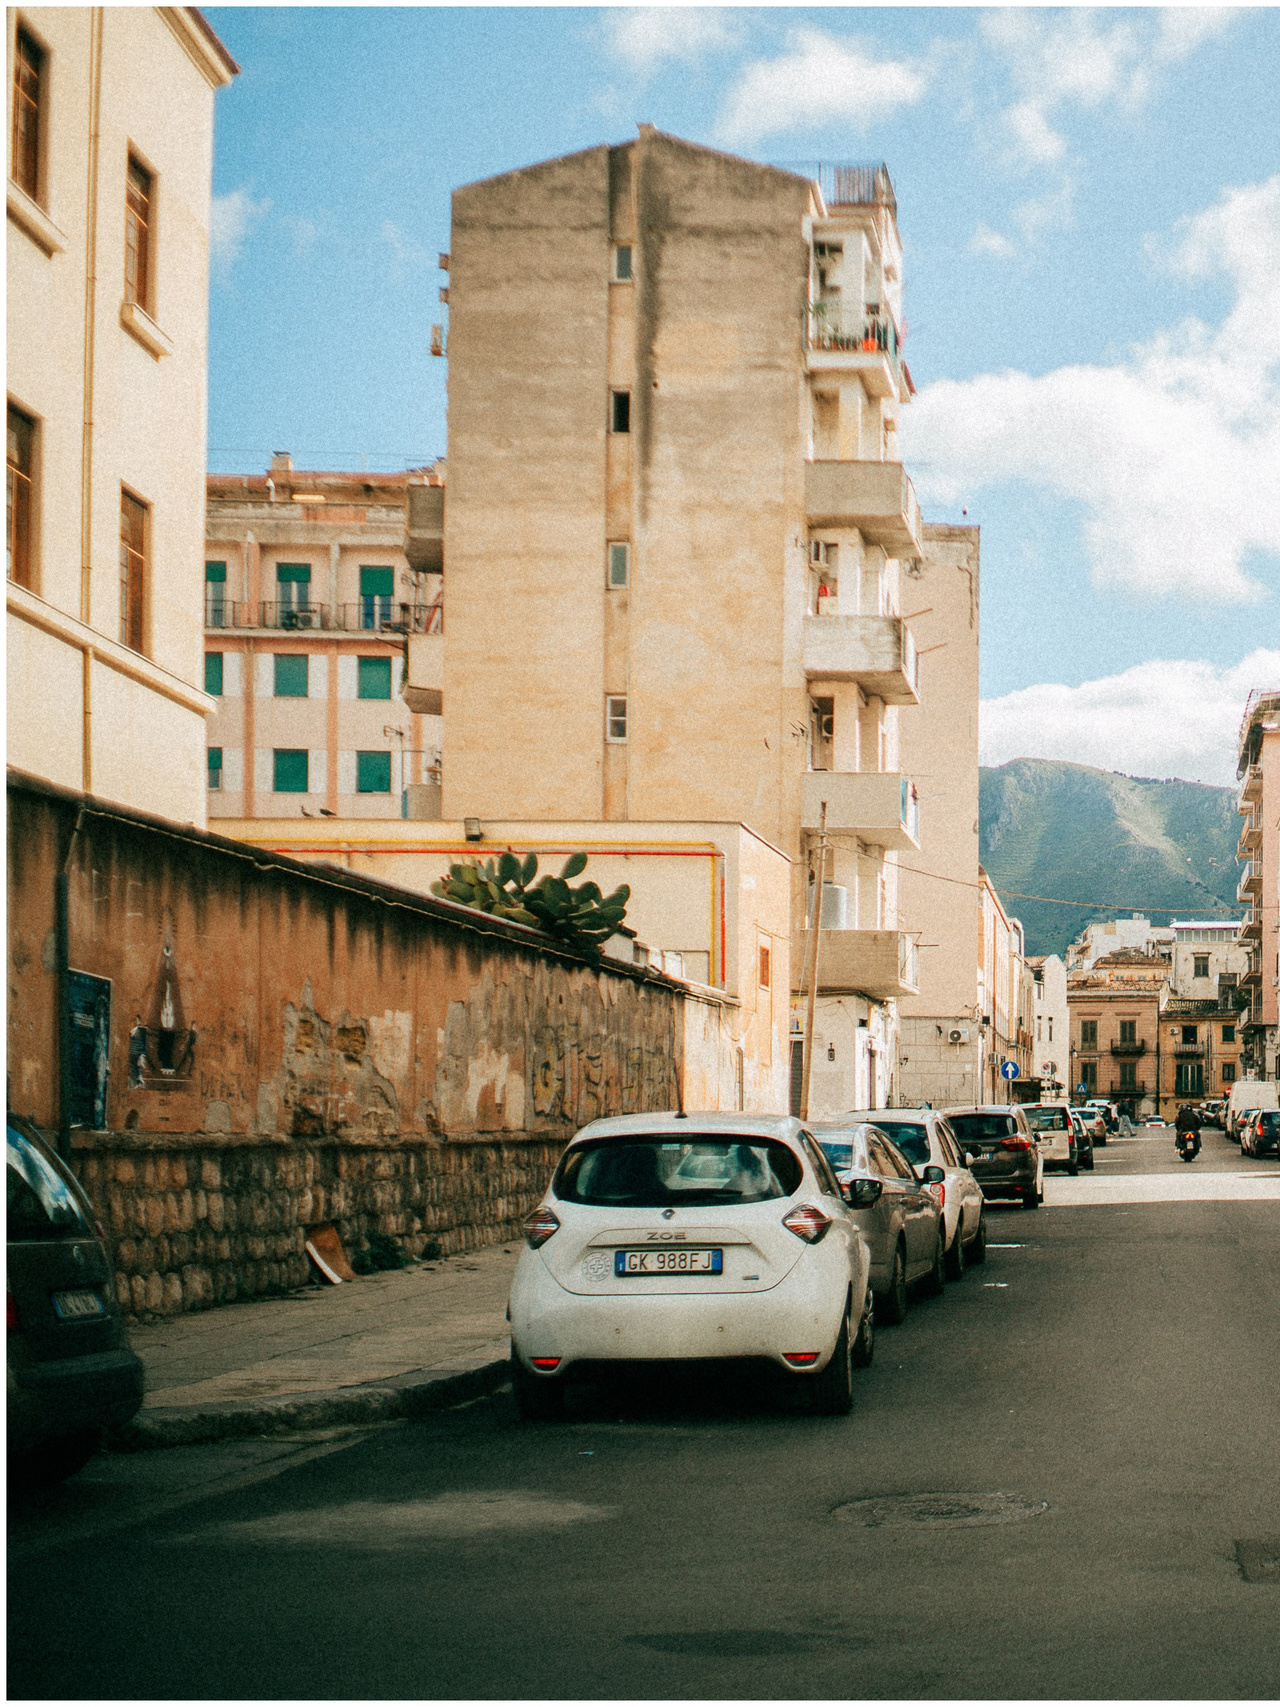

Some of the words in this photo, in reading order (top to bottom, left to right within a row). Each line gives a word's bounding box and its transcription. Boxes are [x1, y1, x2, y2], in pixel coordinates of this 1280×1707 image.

[646, 1231, 687, 1241] ZOE
[627, 1253, 649, 1270] GK
[656, 1252, 711, 1270] 988FJ
